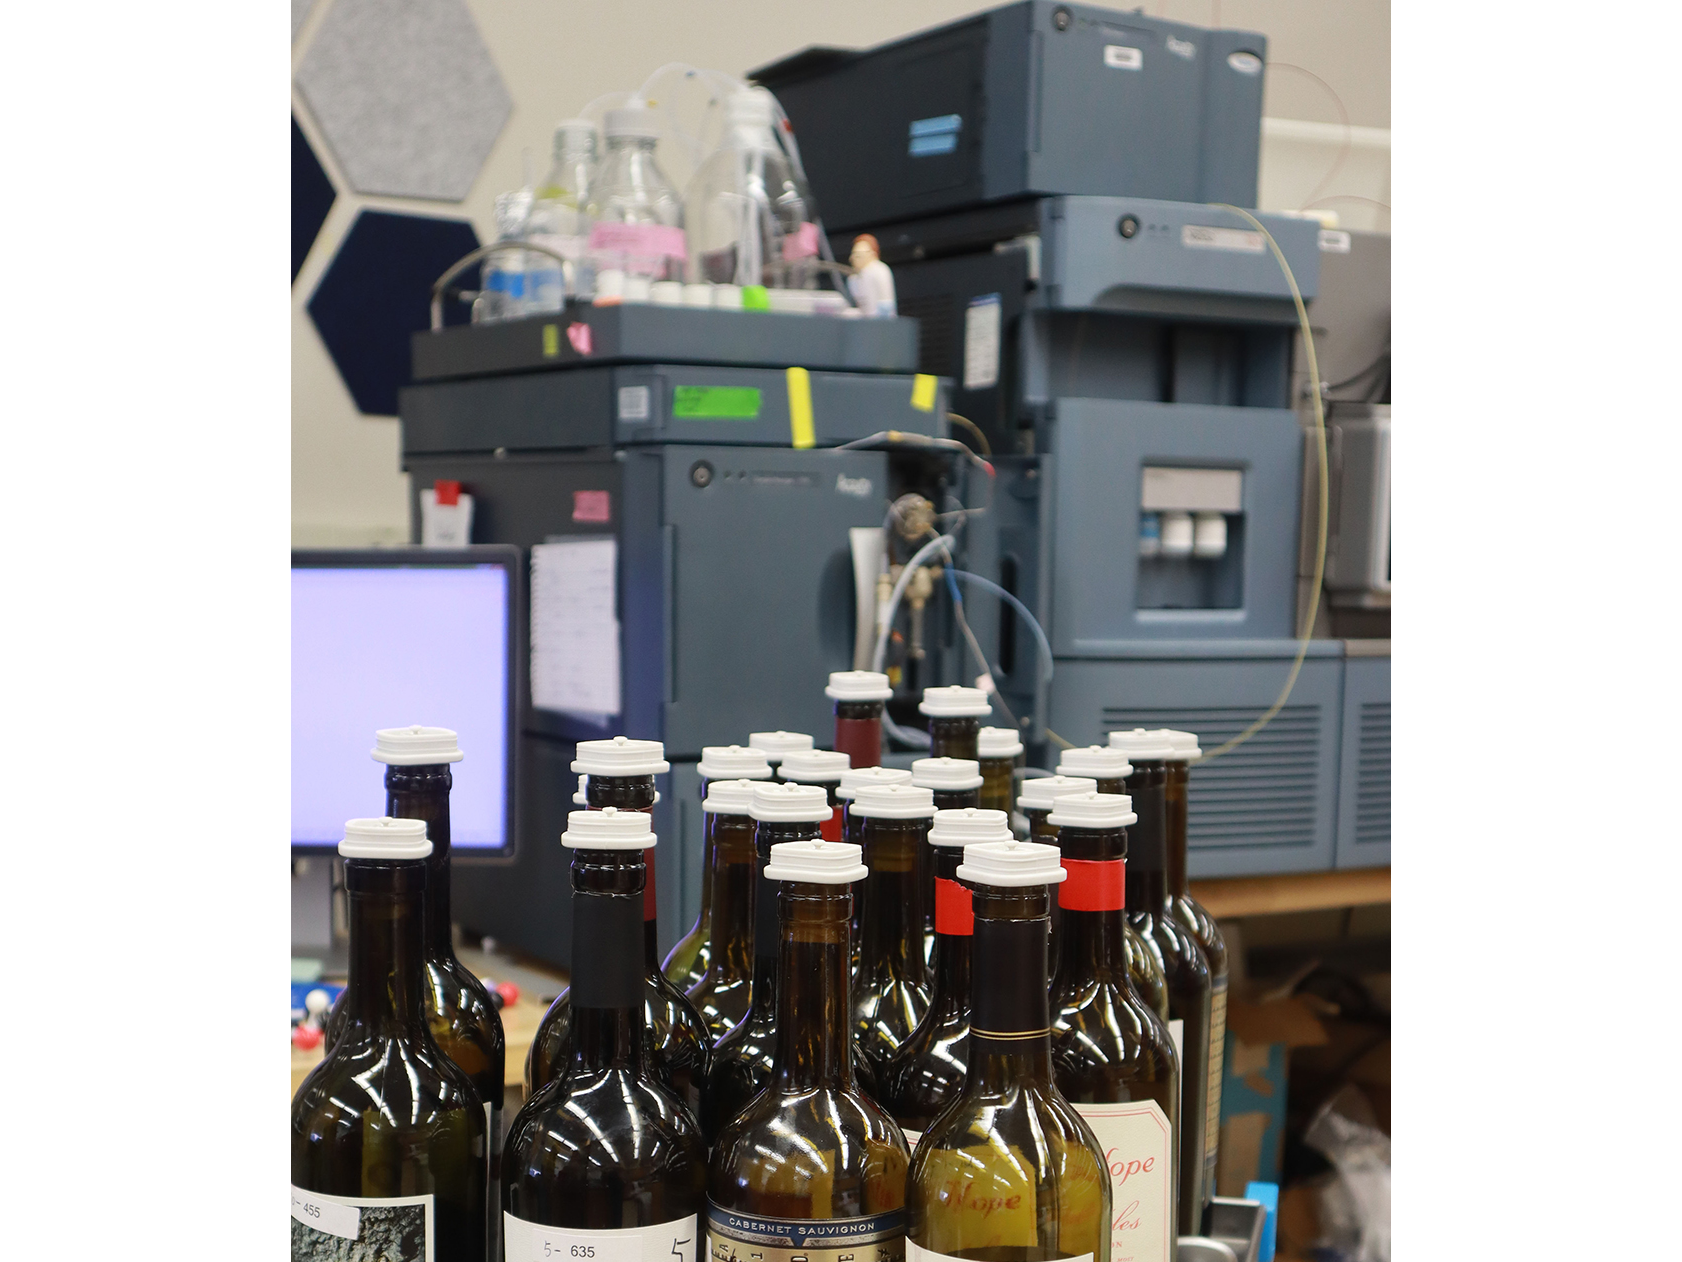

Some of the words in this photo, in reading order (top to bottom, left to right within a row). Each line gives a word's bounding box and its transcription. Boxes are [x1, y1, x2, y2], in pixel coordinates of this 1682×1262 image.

[303, 1202, 321, 1219] 455
[1111, 1200, 1142, 1231] les
[728, 1216, 792, 1235] CABERNET
[797, 1222, 876, 1236] SAUVIGNON
[570, 1244, 596, 1259] 635
